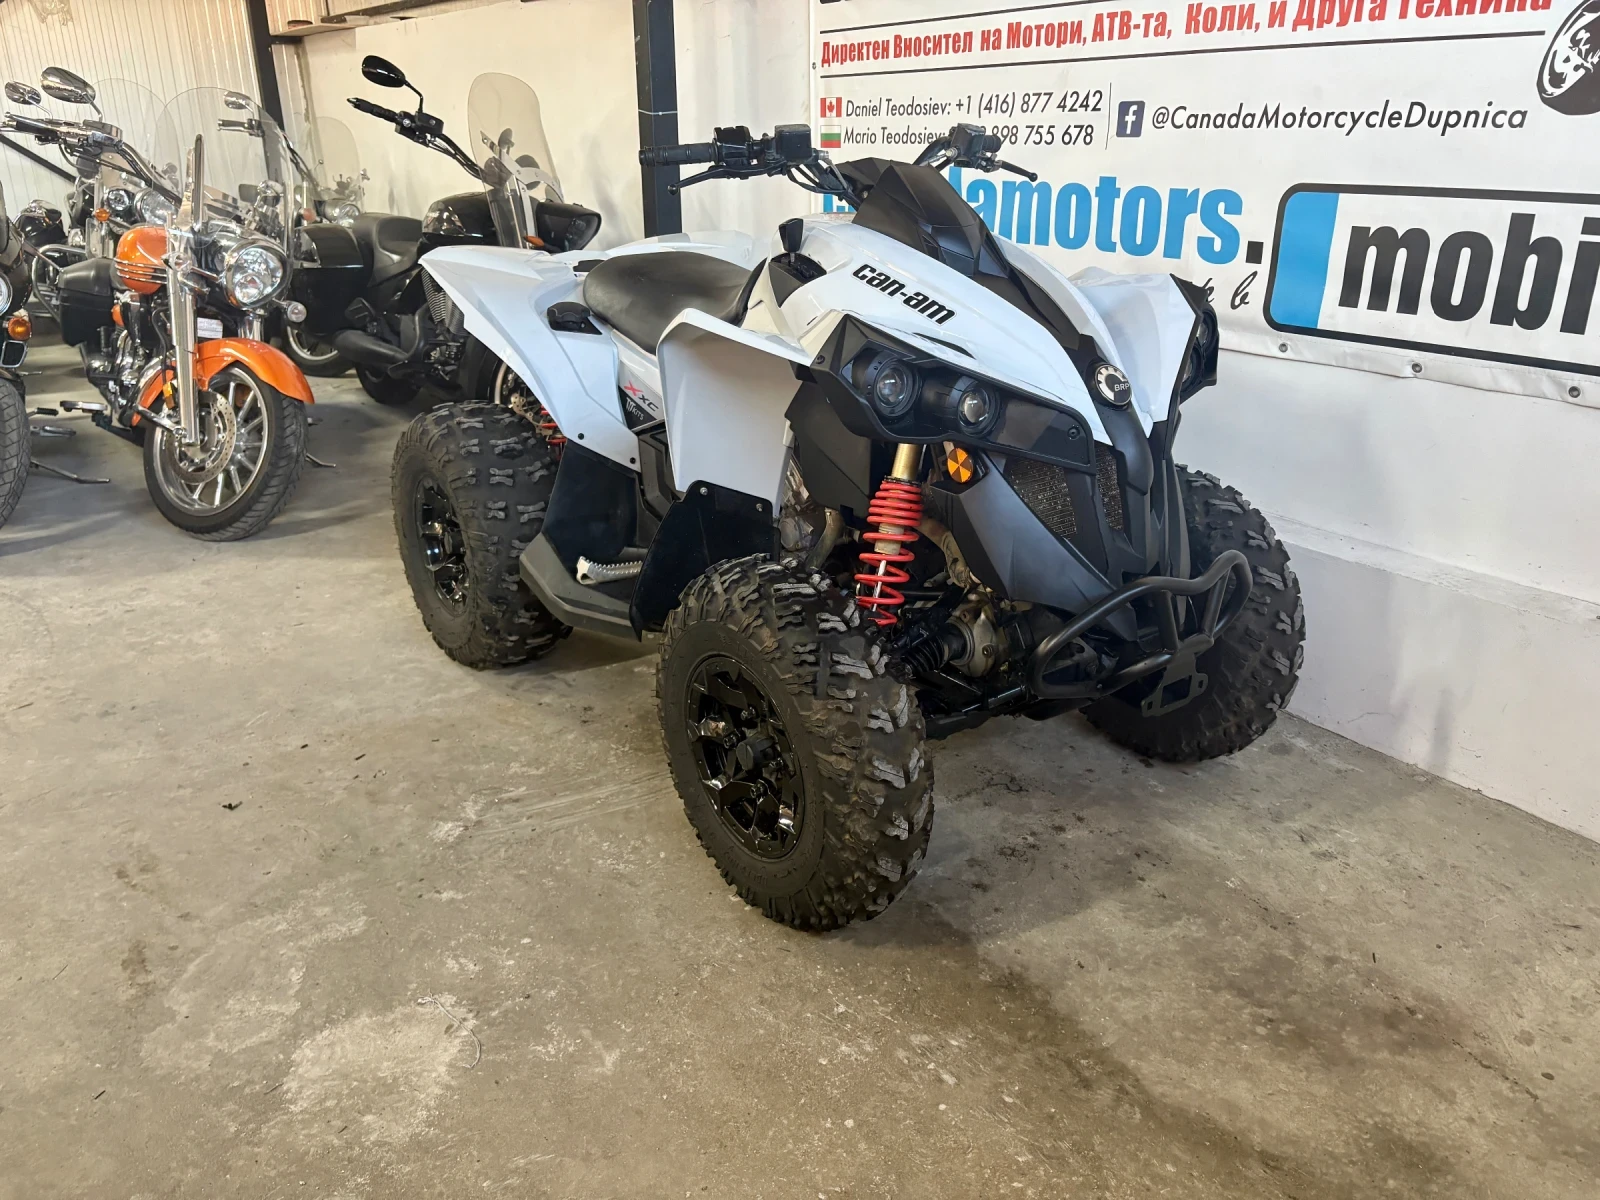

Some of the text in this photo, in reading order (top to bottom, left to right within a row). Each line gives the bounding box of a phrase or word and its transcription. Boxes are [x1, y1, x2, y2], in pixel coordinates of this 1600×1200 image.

[821, 40, 889, 67] Директен
[893, 30, 973, 59] Вносител
[980, 28, 1002, 52] на
[1006, 18, 1087, 49] Мотори,
[1185, 2, 1261, 35] Коли,
[1267, 1, 1288, 28] и
[1291, 0, 1388, 32] Друга
[845, 89, 1103, 119] Daniel Teodosiev: +1 (416) 877 4242
[1152, 99, 1528, 137] @CanadaMotorcycleDupnica
[843, 126, 877, 145] Mario
[1023, 124, 1056, 146] 755
[1061, 124, 1094, 146] 678
[852, 263, 956, 325] can-am
[1114, 382, 1130, 392] BRP
